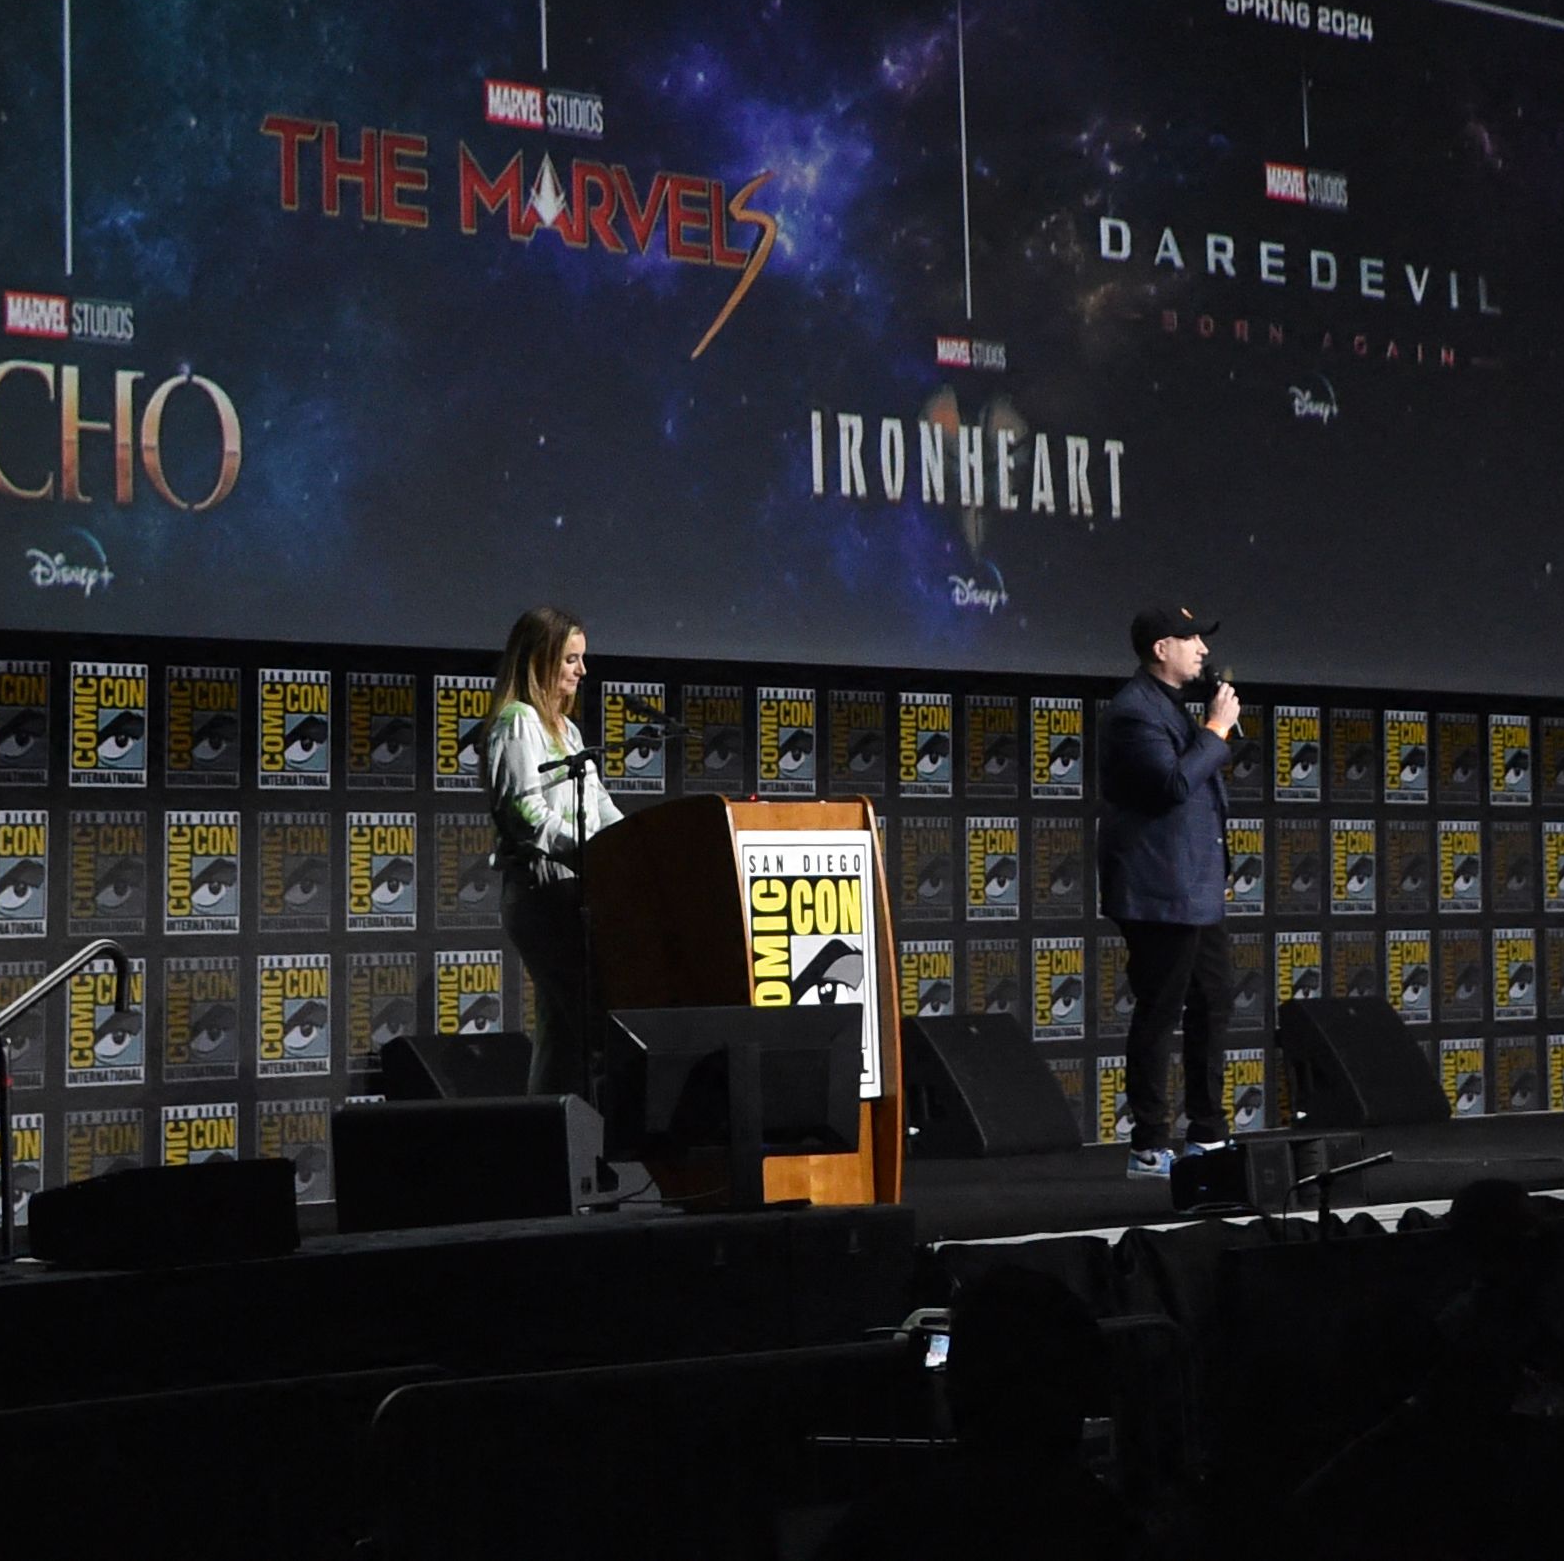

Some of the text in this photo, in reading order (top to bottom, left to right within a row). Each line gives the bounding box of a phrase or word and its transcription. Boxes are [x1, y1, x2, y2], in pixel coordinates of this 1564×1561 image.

[1316, 5, 1374, 43] 2024
[484, 78, 605, 135] MARVEL STUDIOS
[1265, 161, 1349, 210] MARVEL STUDIOS
[260, 113, 775, 361] THE MARVELS
[1099, 216, 1501, 315] DAREDEVIL
[4, 290, 135, 341] MARVEL STUDIOS
[810, 410, 1125, 519] IRONHEART
[99, 677, 146, 708] CON
[286, 683, 329, 712] CON
[779, 700, 814, 727] CON
[73, 678, 98, 768] COMIC
[261, 684, 286, 771] COMIC
[761, 702, 780, 779] COMIC
[1034, 711, 1051, 783] COMIC
[1050, 711, 1081, 734] CON
[1401, 723, 1426, 745] CON
[1388, 723, 1401, 789] COMIC
[193, 825, 238, 855] CON
[373, 827, 414, 855] CON
[748, 853, 863, 874] SAN DIEGO
[969, 831, 987, 905] COMIC
[987, 830, 1017, 854] CON
[168, 826, 194, 916] COMIC
[350, 827, 373, 914] COMIC
[790, 877, 863, 936] CON
[750, 877, 791, 1007] OMIC
[1052, 951, 1083, 975] CON
[285, 969, 328, 998] CON
[1036, 952, 1052, 1025] COMIC
[261, 970, 285, 1059] COMIC
